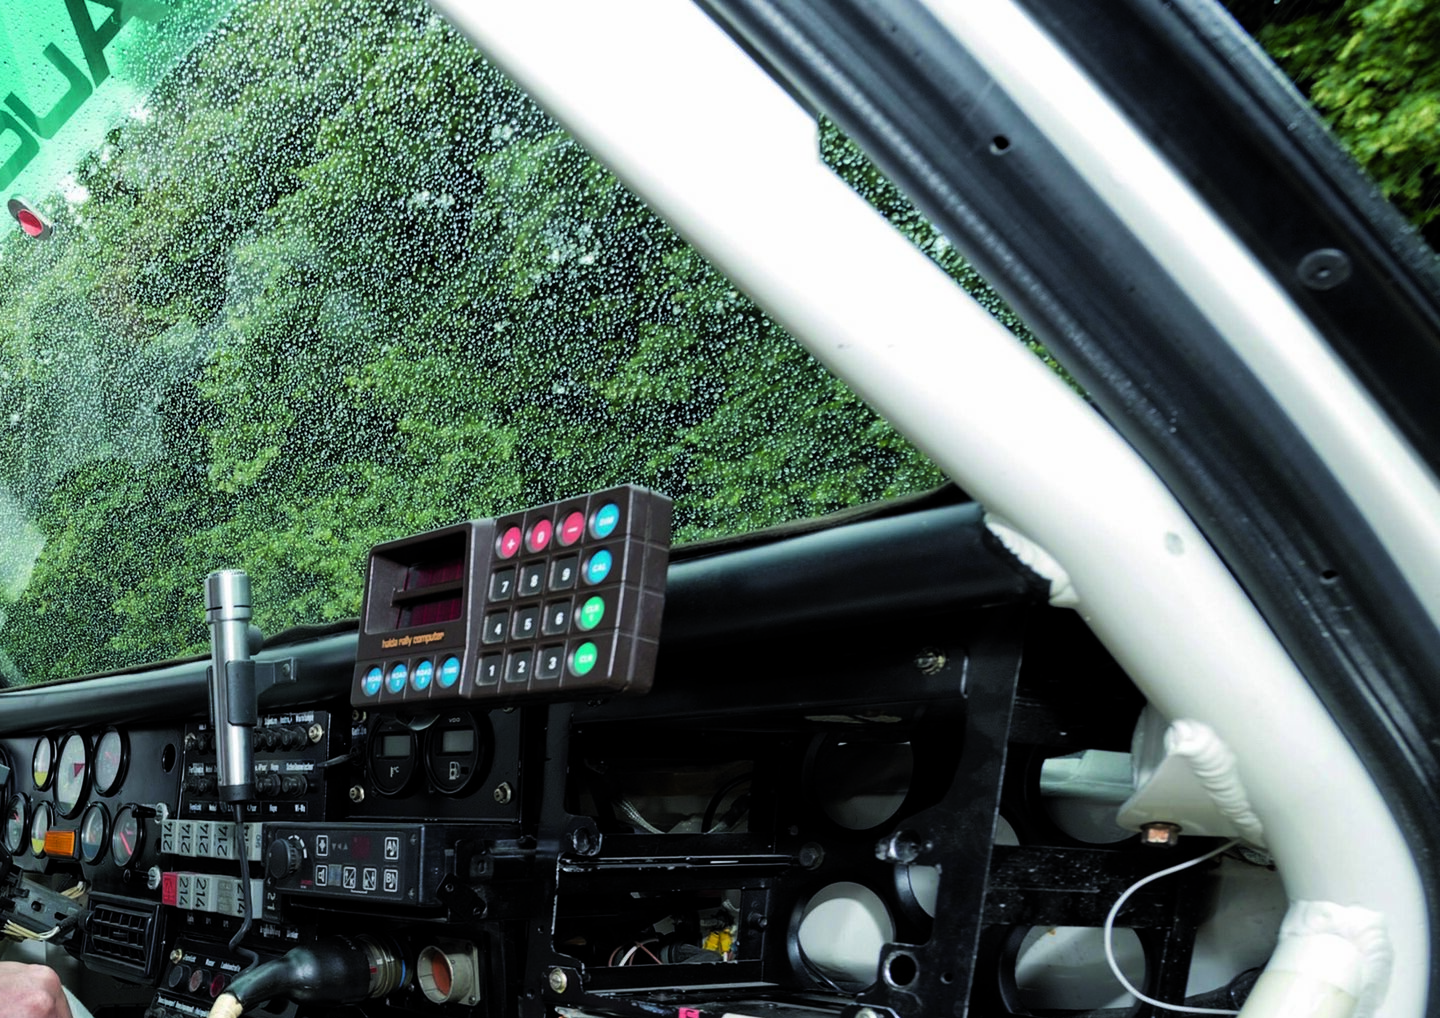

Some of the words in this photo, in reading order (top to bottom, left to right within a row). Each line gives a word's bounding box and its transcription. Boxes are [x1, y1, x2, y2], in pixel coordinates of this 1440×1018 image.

[501, 581, 510, 594] 7
[529, 574, 539, 588] 8
[561, 567, 571, 582] 9
[412, 631, 445, 645] computer
[494, 623, 502, 637] 4
[522, 618, 533, 632] 5
[555, 612, 564, 626] 6
[488, 664, 495, 677] 1
[517, 660, 526, 674] 2
[549, 656, 558, 670] 3
[163, 822, 173, 851] 214
[181, 823, 191, 853] 214
[199, 823, 209, 853] 214
[217, 825, 229, 856] 214
[179, 877, 189, 905] 214
[195, 878, 207, 907] 214
